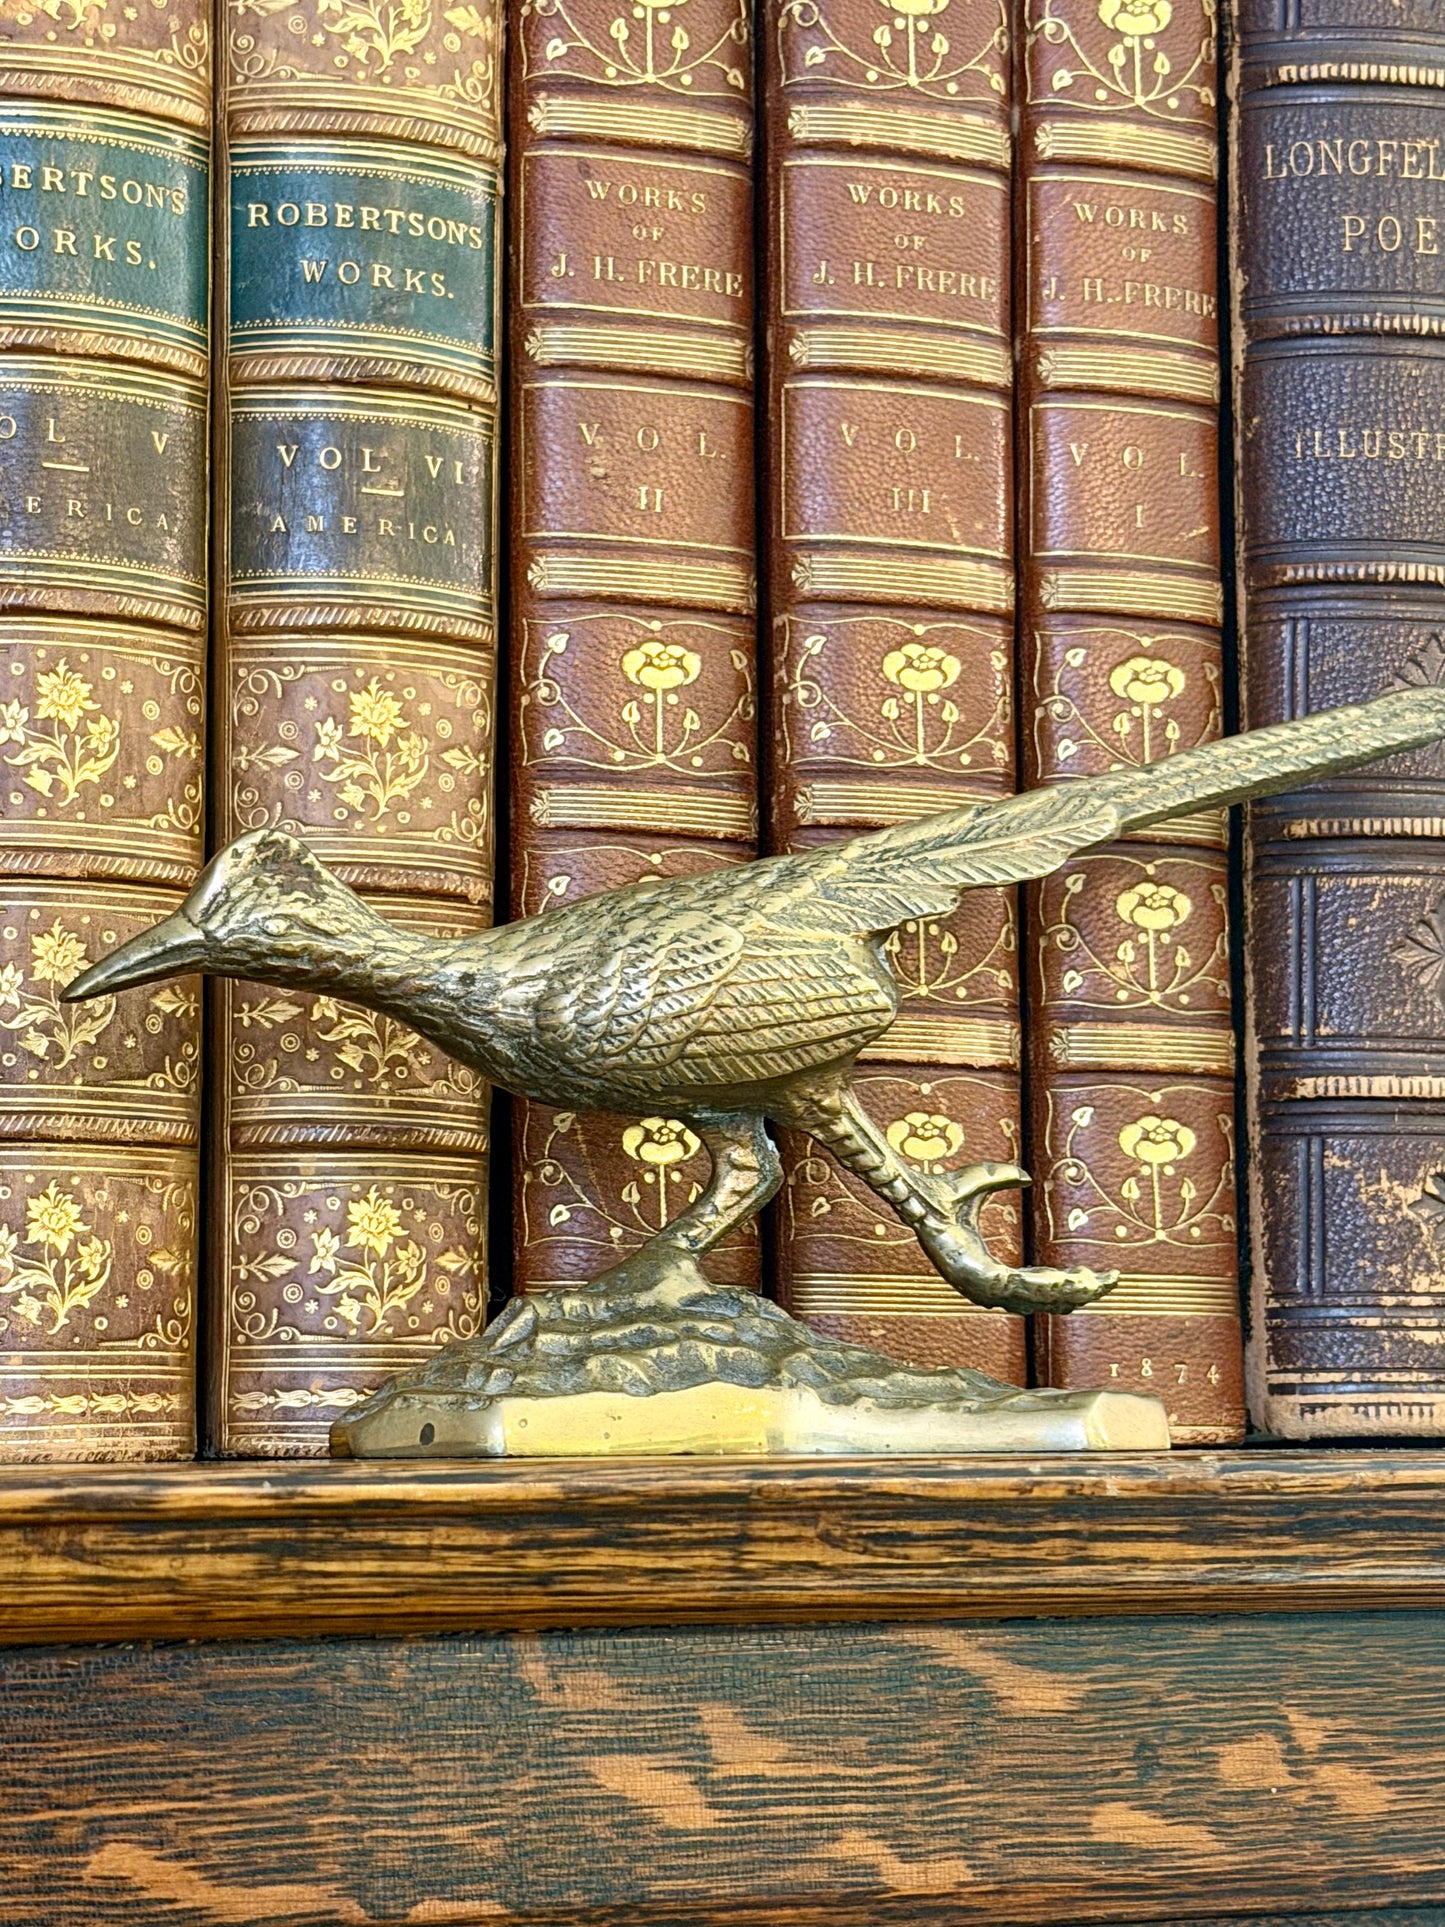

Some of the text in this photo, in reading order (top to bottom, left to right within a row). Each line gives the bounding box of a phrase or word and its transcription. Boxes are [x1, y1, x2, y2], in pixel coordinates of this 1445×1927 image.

[0, 163, 185, 215] ERTSON'S
[585, 179, 706, 214] WORKS
[847, 183, 965, 218] WORKS
[247, 202, 482, 249] ROBERTSON'S
[632, 224, 665, 242] OF
[1073, 202, 1189, 235] WORKS
[1342, 215, 1438, 255] POE
[894, 233, 926, 250] OF
[1121, 246, 1152, 263] OF
[300, 259, 454, 299] WORKS.
[551, 253, 743, 298] J. H. FRERE
[812, 260, 998, 302] J. H. FRERE
[1042, 277, 1066, 301] J.
[151, 431, 169, 455] V
[578, 422, 727, 459] VOL.
[841, 422, 980, 462] VOL.
[276, 445, 465, 485] VOL VI
[26, 496, 169, 531] ERICA
[638, 486, 663, 513] II
[892, 487, 931, 514] III
[1135, 504, 1145, 529] I
[270, 515, 455, 546] AMERICA
[1109, 1357, 1221, 1385] 1874
